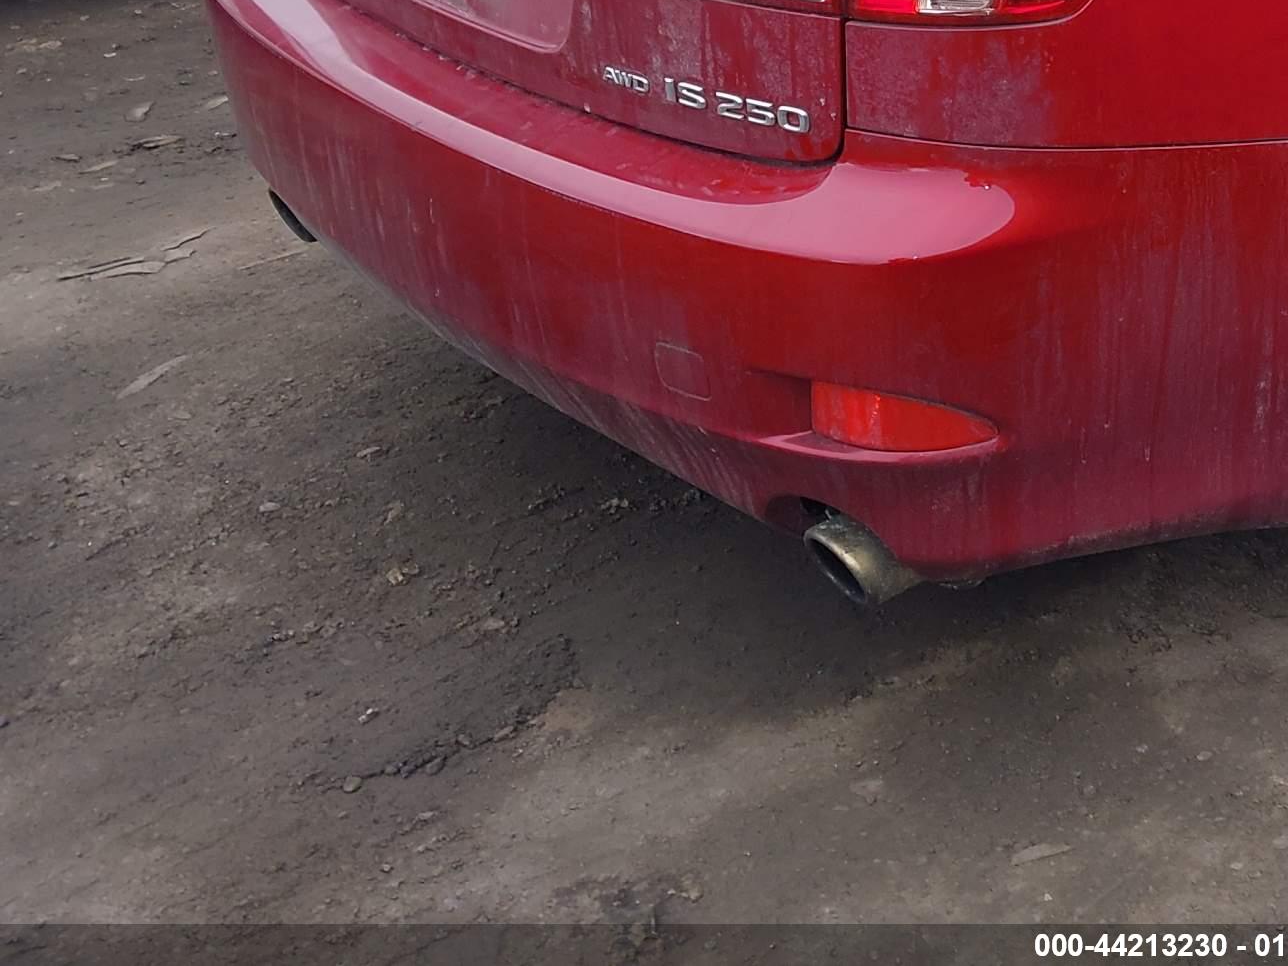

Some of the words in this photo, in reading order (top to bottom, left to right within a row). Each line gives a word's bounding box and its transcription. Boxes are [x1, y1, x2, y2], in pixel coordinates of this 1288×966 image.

[603, 66, 650, 94] AWD
[664, 77, 707, 110] IS
[715, 91, 810, 133] 250
